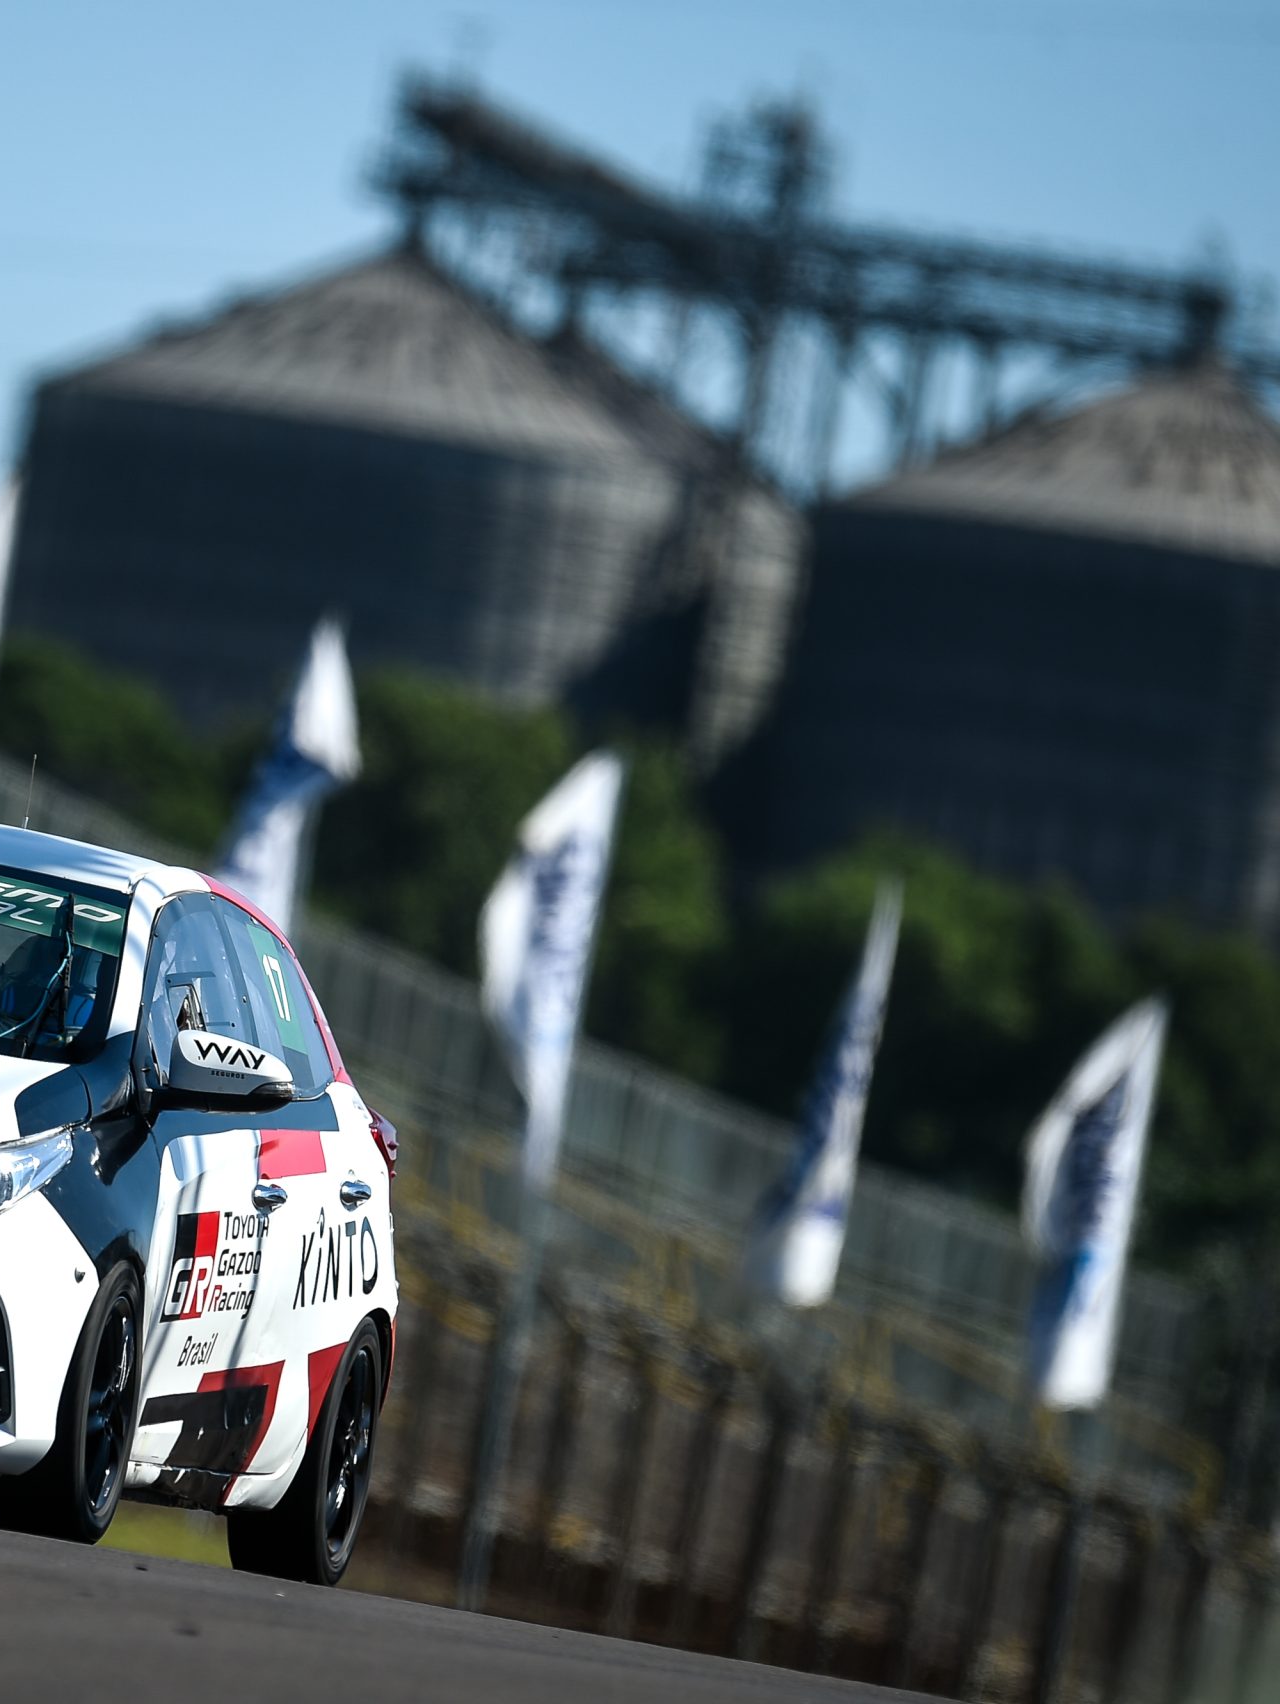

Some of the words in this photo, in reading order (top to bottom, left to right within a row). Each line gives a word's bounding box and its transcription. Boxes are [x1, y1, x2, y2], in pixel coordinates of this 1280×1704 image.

[262, 954, 291, 1022] 17
[192, 1039, 267, 1071] WAY
[210, 1070, 246, 1080] SEGUROS
[224, 1211, 270, 1241] TOYOTA
[217, 1248, 262, 1277] GAZOO
[164, 1254, 215, 1317] GR
[207, 1283, 256, 1320] Racing
[177, 1333, 219, 1367] Brasil
